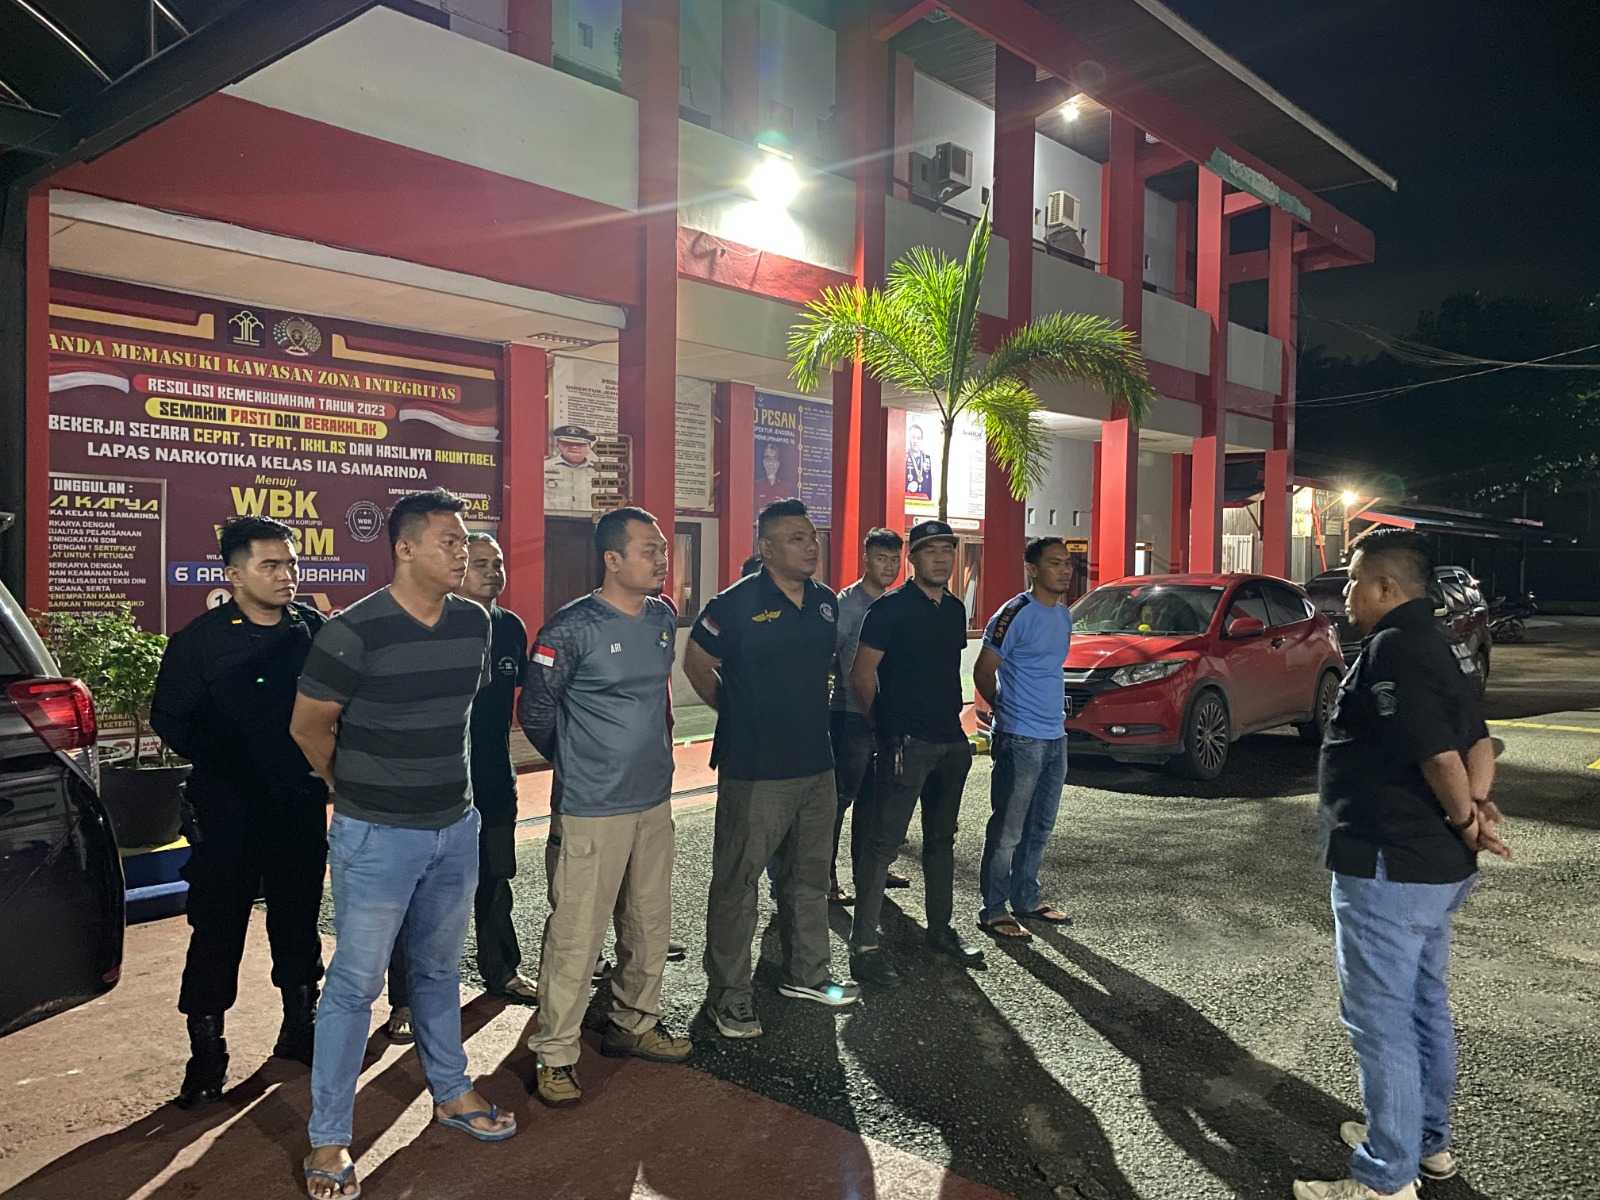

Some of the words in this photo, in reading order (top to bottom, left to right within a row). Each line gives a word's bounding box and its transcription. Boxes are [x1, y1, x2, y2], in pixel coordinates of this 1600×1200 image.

[48, 333, 105, 356] ANDA
[111, 342, 220, 370] MEMASUKI
[226, 358, 313, 382] KAWASAN
[318, 370, 360, 389] ZONA
[365, 376, 456, 400] INTEGRITAS
[148, 378, 214, 398] RESOLUSI
[218, 386, 314, 409] KEMENKUMHAM
[318, 398, 354, 412] TAHUN
[357, 402, 385, 416] 2023
[160, 401, 226, 422] SEMAKIN
[230, 408, 271, 426] PASTI
[275, 413, 300, 428] DAN
[304, 416, 376, 436] BERAKHLAK
[761, 408, 796, 429] PESAN
[48, 414, 124, 436] BEKERJA
[130, 422, 189, 441] SECARA
[300, 438, 346, 454] IKHLAS
[350, 442, 372, 457] DAN
[376, 444, 432, 461] HASILNYA
[435, 450, 496, 466] AKUNTABEL
[88, 442, 150, 460] LAPAS
[156, 448, 257, 468] NARKOTIKA
[262, 455, 312, 472] KELAS
[317, 460, 338, 473] IIA
[340, 462, 428, 480] SAMARINDA
[54, 478, 125, 494] UNGGULAN
[255, 474, 297, 488] Menuju
[230, 486, 319, 518] WBK
[110, 512, 160, 520] SAMARINDA
[98, 552, 134, 560] PETUGAS
[174, 566, 189, 582] 6
[83, 600, 116, 608] TINGKAT
[610, 642, 622, 654] ARI
